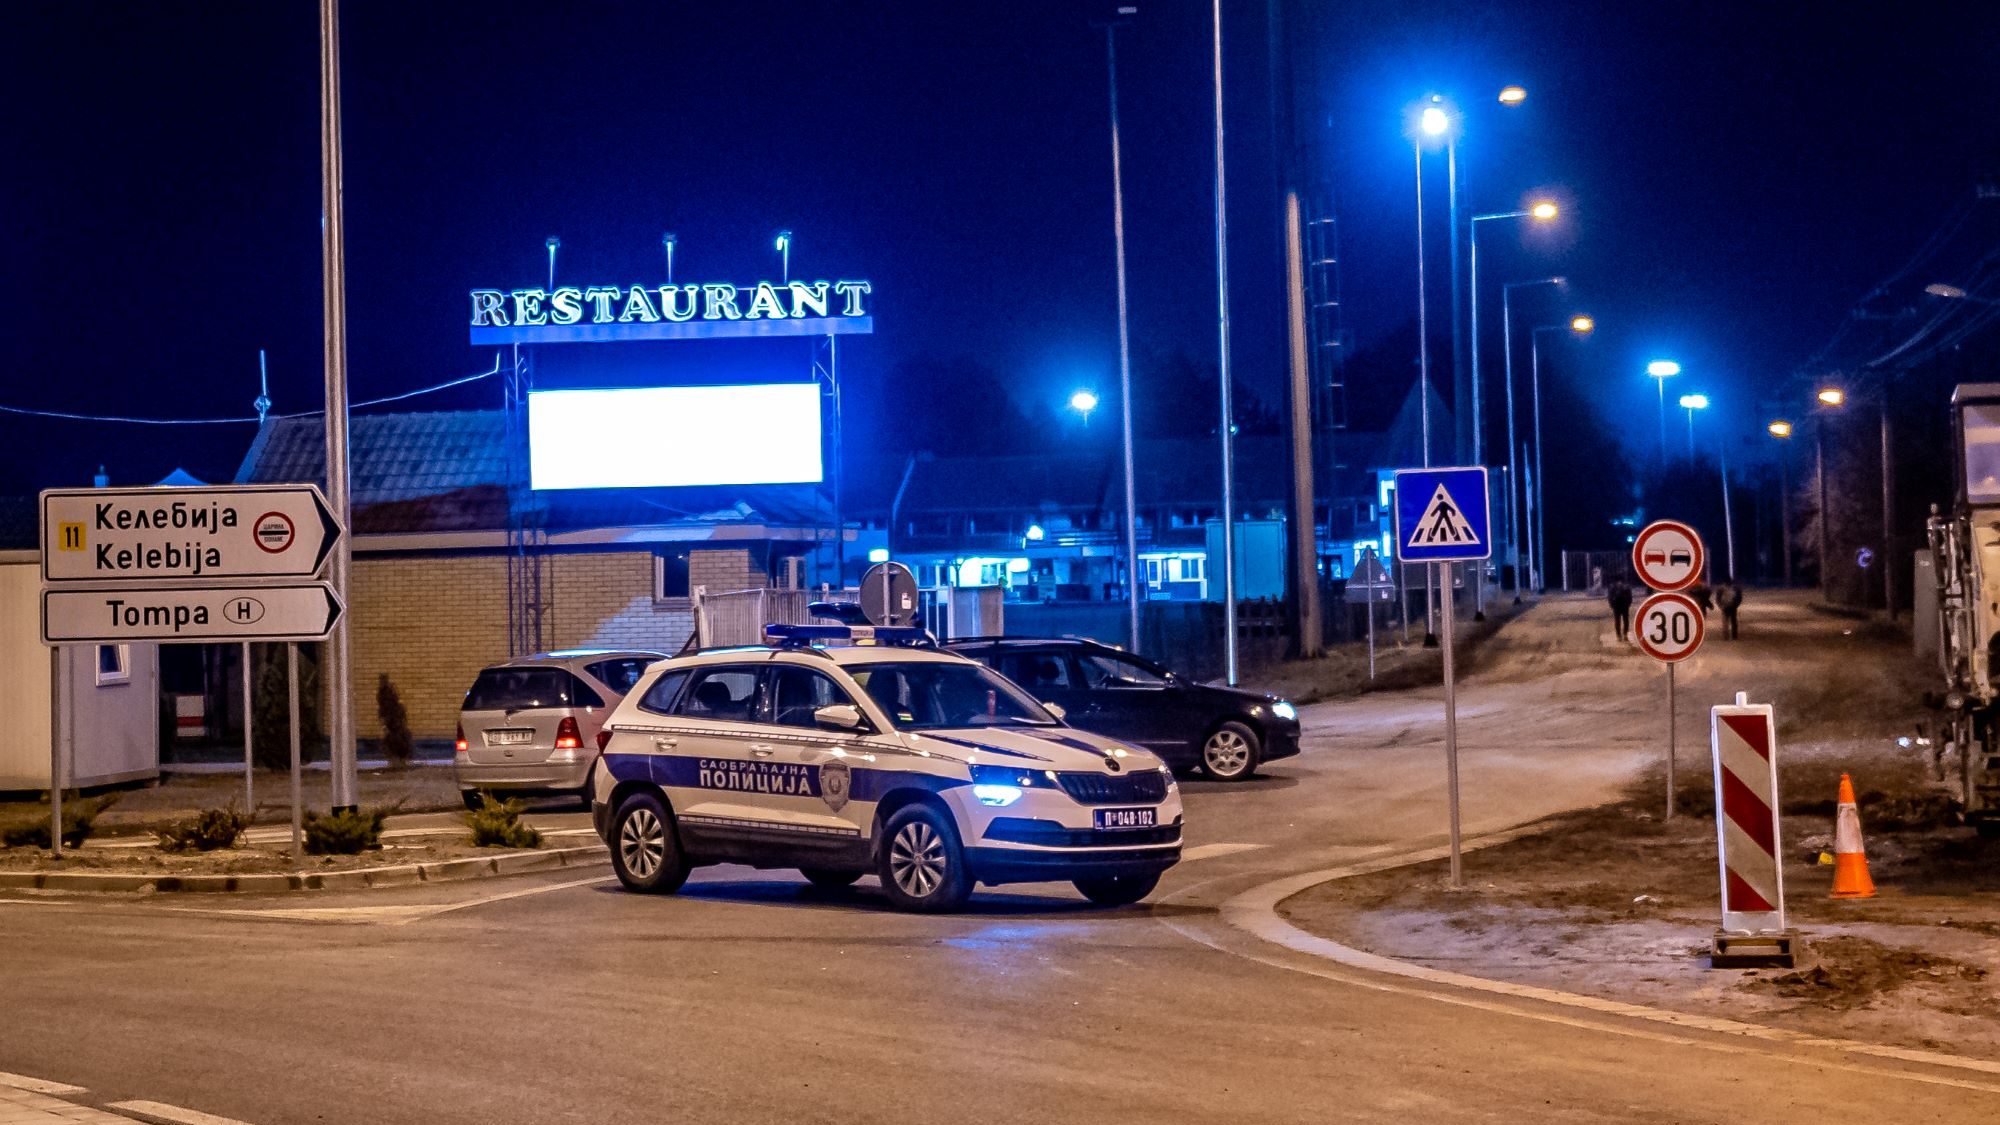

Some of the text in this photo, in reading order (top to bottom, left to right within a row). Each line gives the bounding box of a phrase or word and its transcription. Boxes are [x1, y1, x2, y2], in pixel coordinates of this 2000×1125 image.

[470, 280, 872, 327] RESTAURANT
[95, 502, 238, 534] Келебија
[65, 526, 79, 548] 11
[95, 543, 222, 575] Kelebija
[105, 600, 251, 632] Tompa H
[1650, 611, 1690, 645] 30
[700, 759, 809, 776] САОБРАЋАЈНА
[700, 769, 812, 795] ПОЛИЦИЈА
